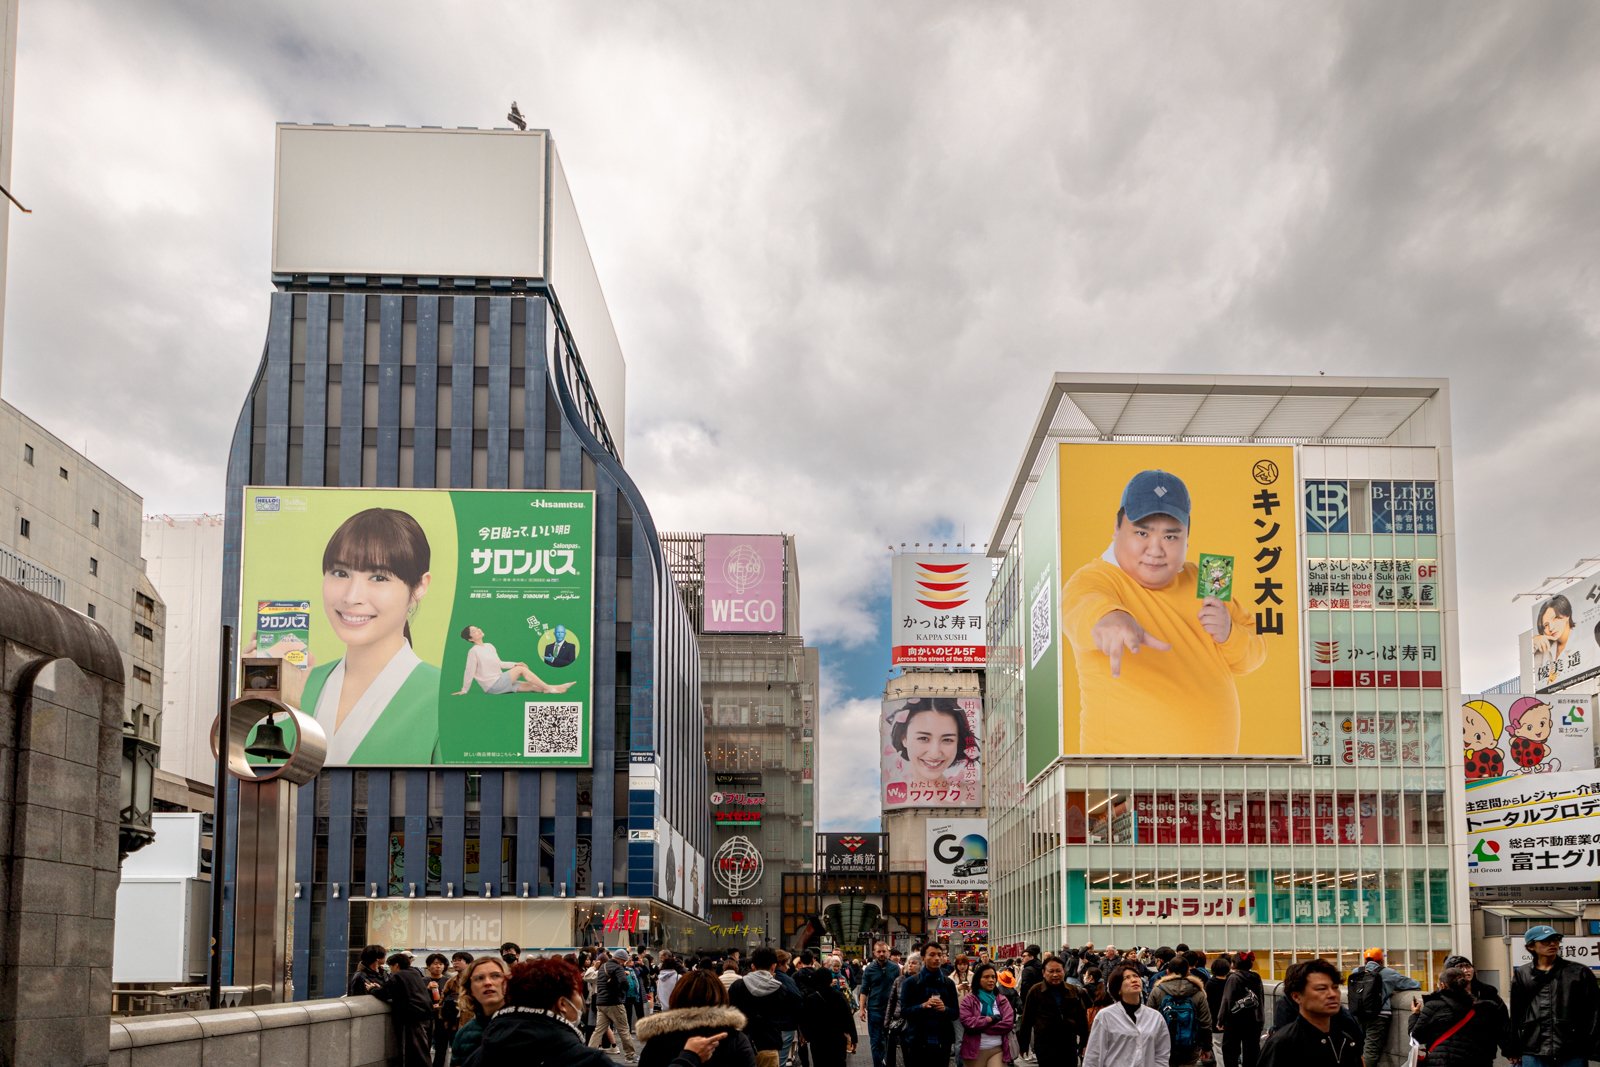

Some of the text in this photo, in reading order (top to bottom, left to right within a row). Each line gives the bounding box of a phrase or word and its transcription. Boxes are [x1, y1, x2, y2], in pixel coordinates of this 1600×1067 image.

[1373, 487, 1434, 499] B-LINE
[531, 499, 584, 508] Hisamitsu
[1384, 500, 1434, 510] CLINIC
[479, 525, 570, 540] 今日貼って、いい明日
[471, 549, 576, 575] サロンパス
[1253, 489, 1284, 635] キング大山
[1418, 565, 1437, 577] 6F
[1309, 582, 1349, 596] 神戸牛
[712, 600, 776, 622] WEGO
[261, 616, 307, 628] サロンパス
[904, 615, 982, 629] かっぱ寿司
[908, 647, 976, 656] 向かいのビル5F
[910, 790, 961, 801] ワクワク
[1139, 802, 1207, 811] Scenic Place
[1211, 800, 1243, 820] 3F
[1281, 804, 1311, 816] Tax
[1318, 804, 1355, 816] Free
[1166, 817, 1187, 825] Spot
[830, 853, 875, 864] 心斎橋筋
[1127, 898, 1233, 917] サンドラッグ
[602, 909, 639, 933] H&M
